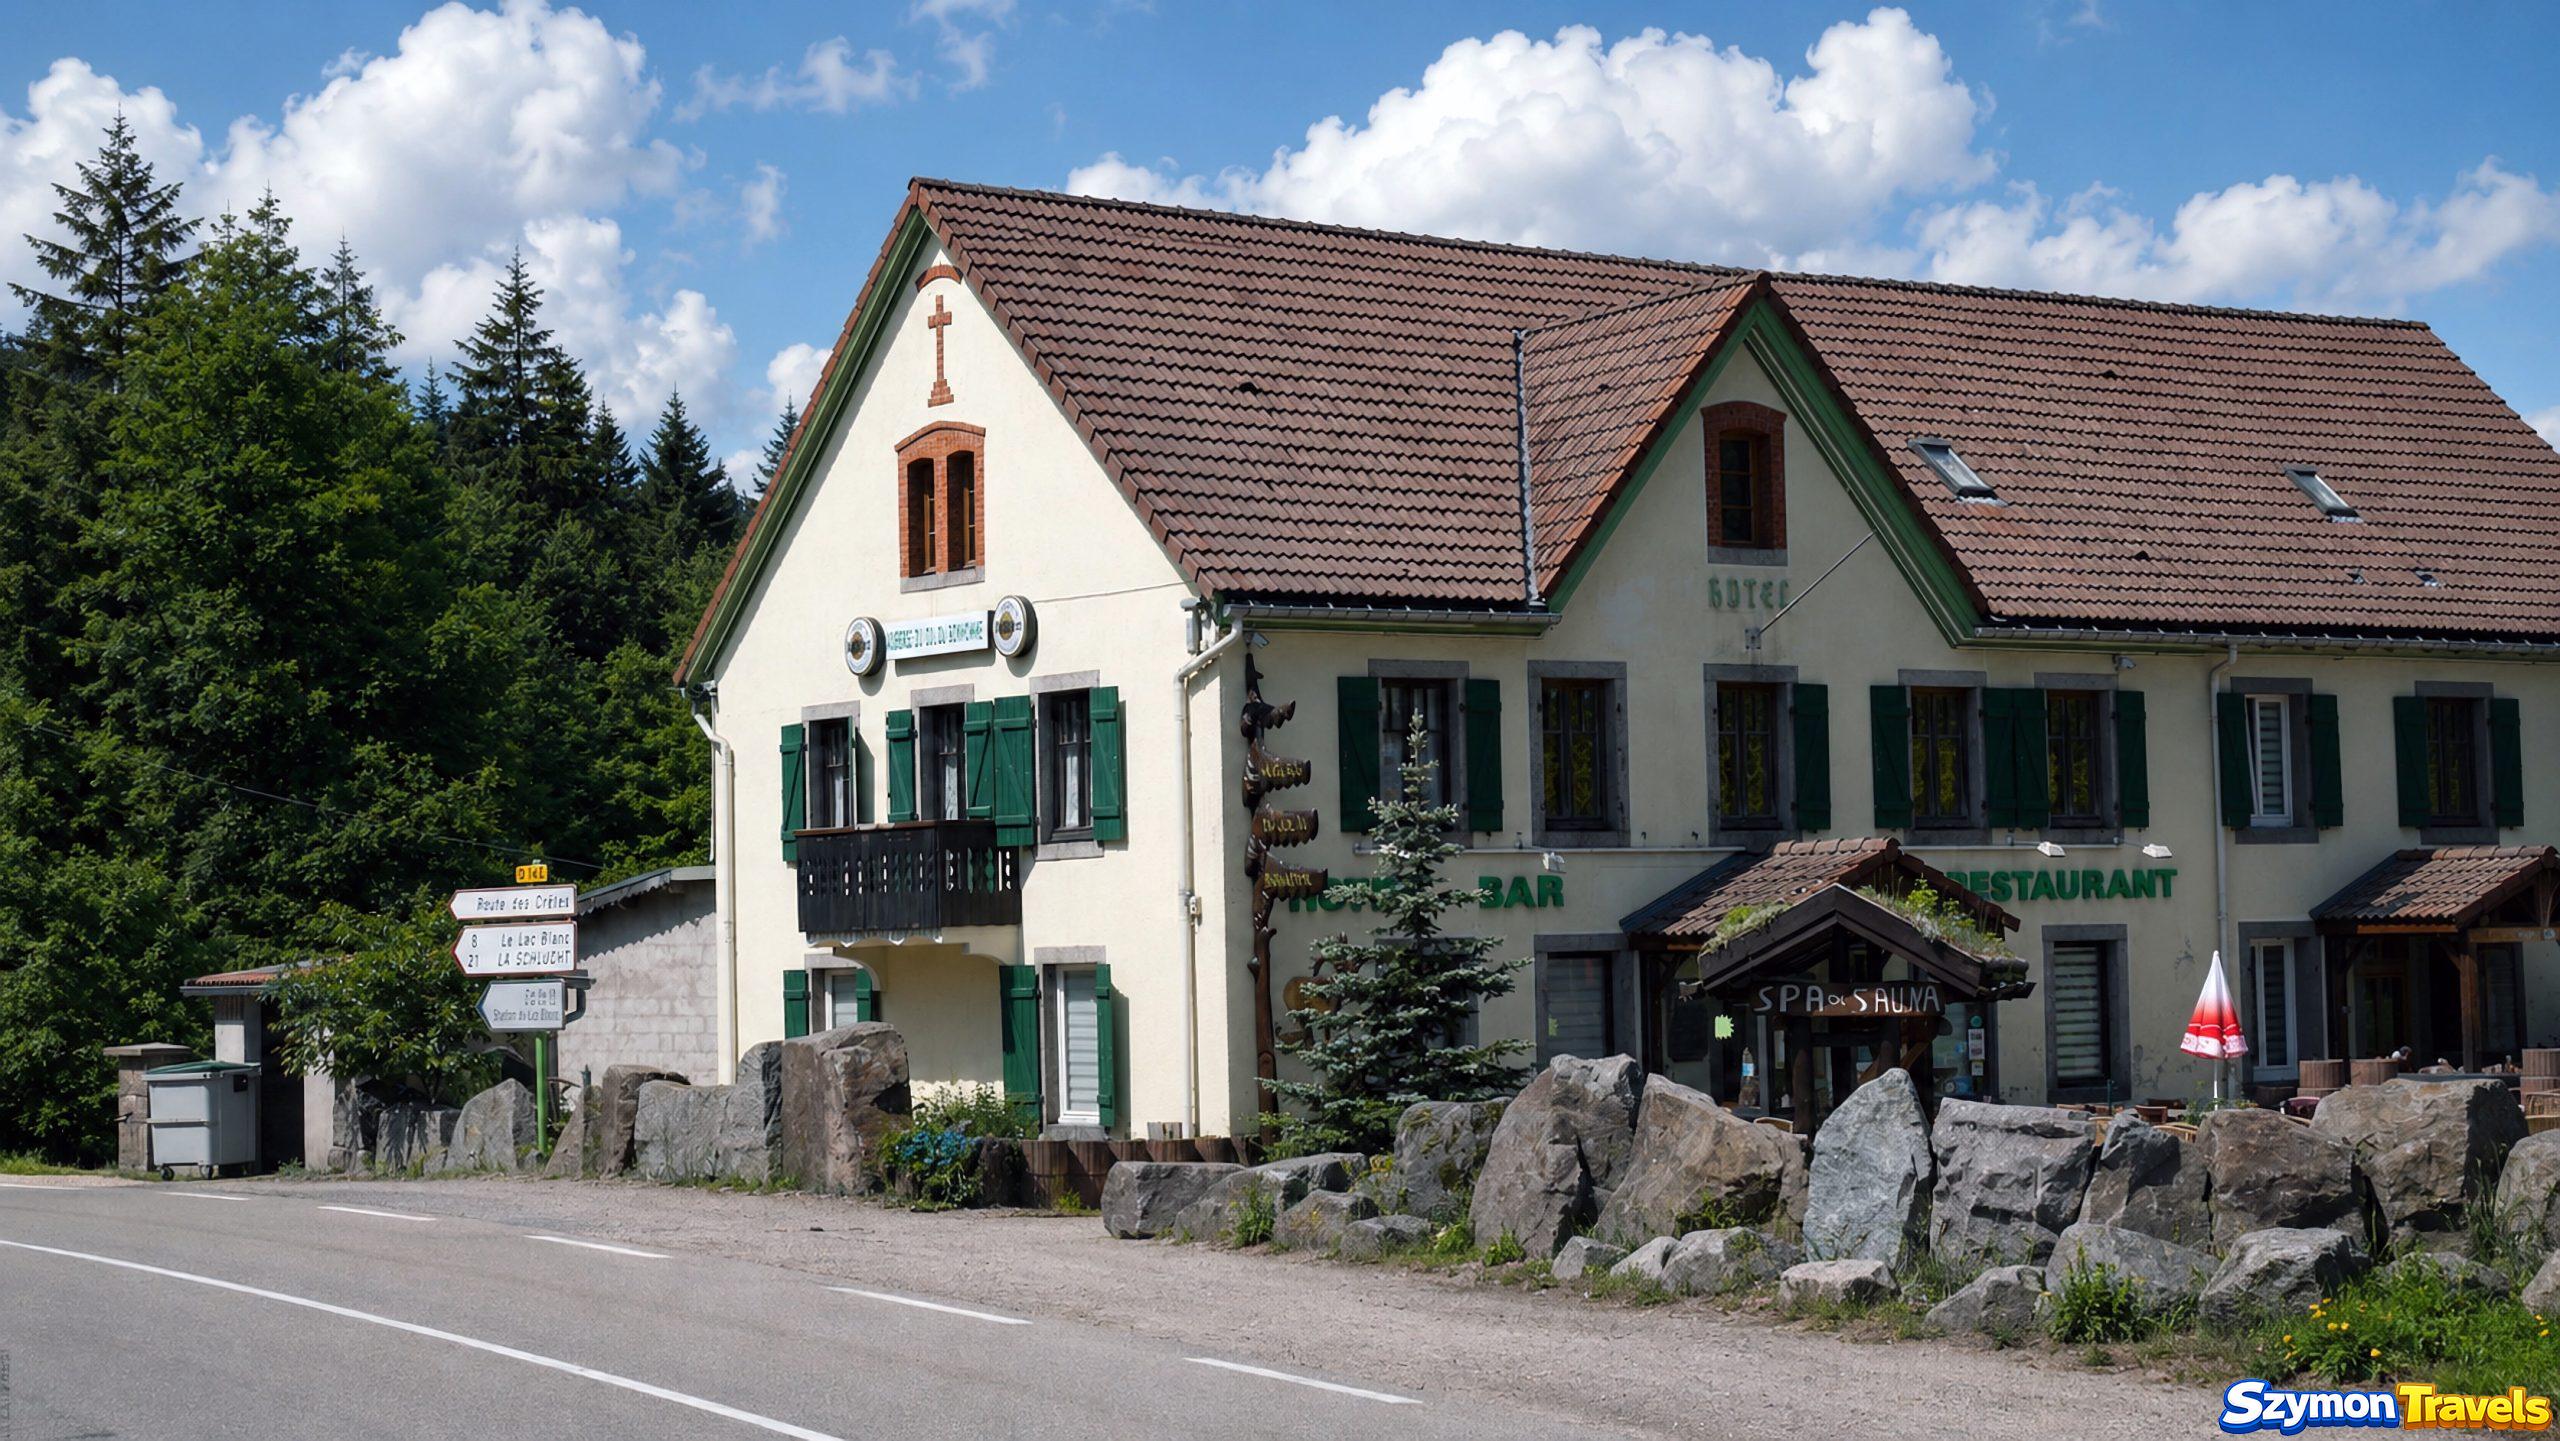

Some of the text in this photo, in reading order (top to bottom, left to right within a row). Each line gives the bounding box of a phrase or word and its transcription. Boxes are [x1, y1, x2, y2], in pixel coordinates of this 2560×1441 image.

[1478, 874, 1565, 909] BAR
[1946, 868, 2178, 900] RESTAURANT
[471, 930, 570, 949] 8 Le Lac Blanc
[468, 953, 480, 968] 21
[497, 951, 511, 967] LA
[1754, 984, 1825, 1013] SPA
[1852, 985, 1942, 1013] SAUNA
